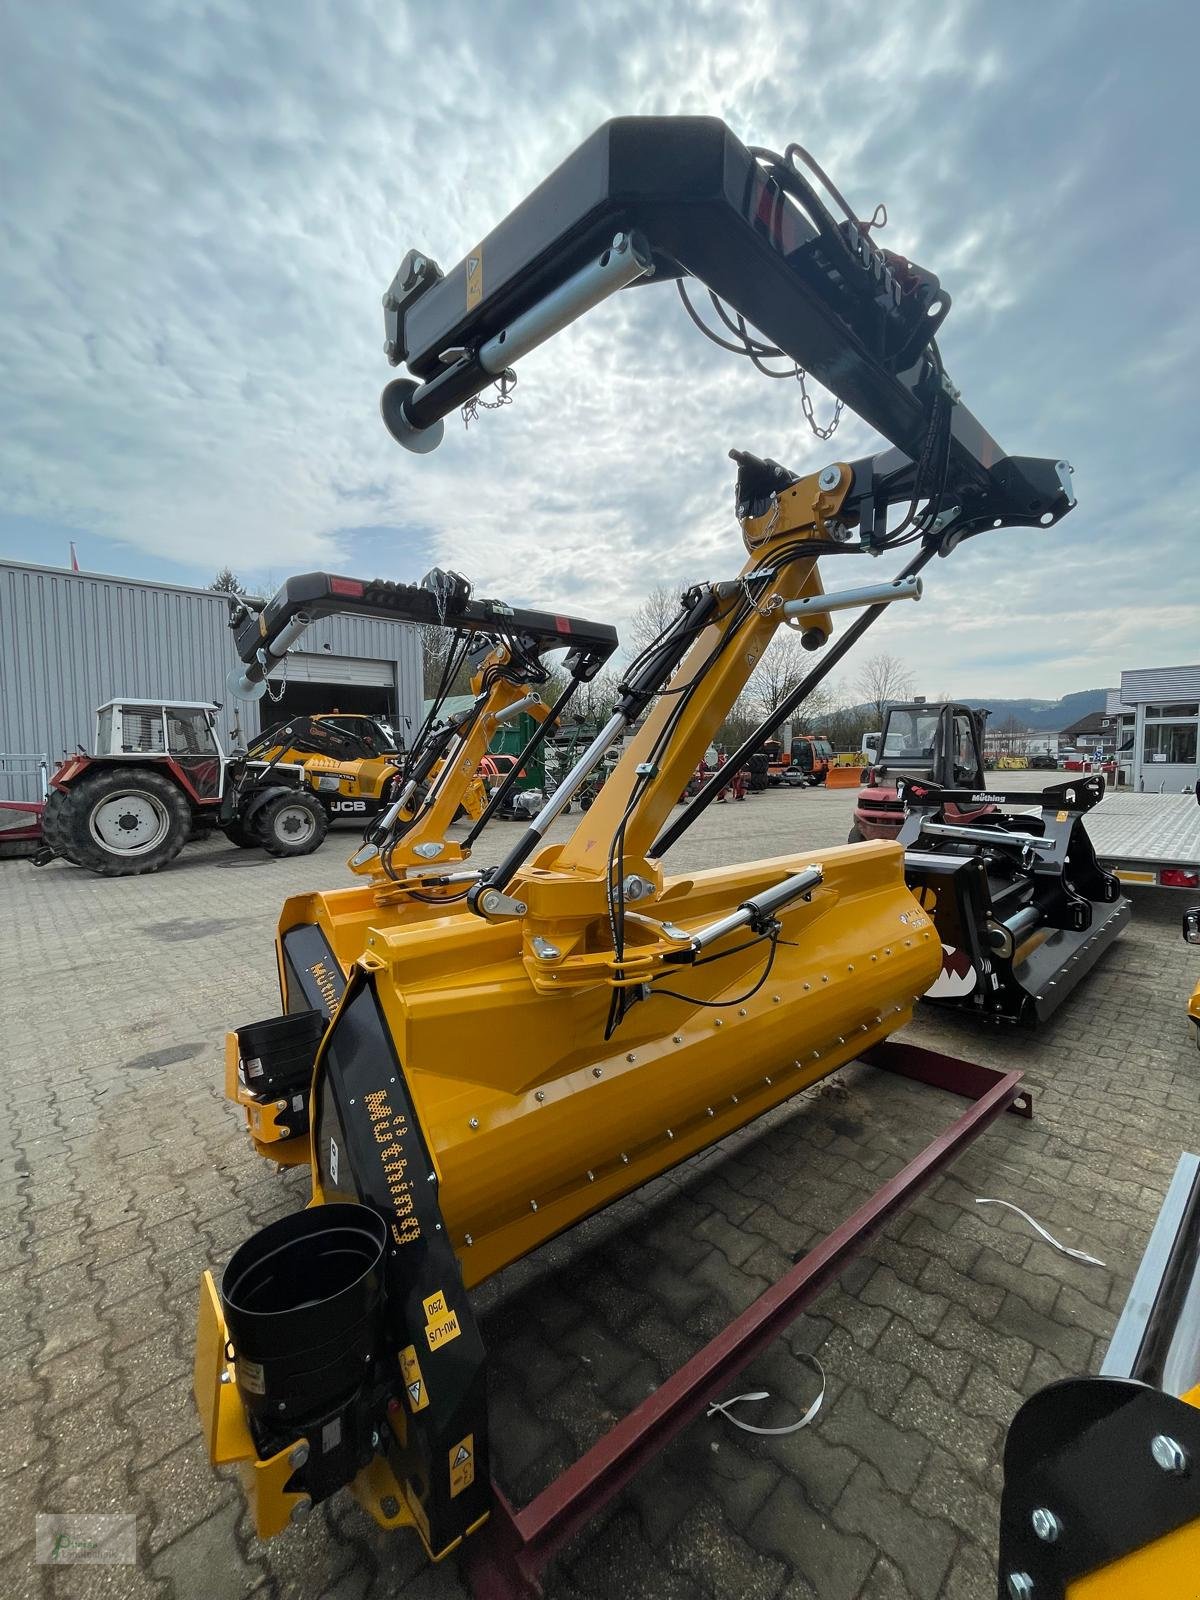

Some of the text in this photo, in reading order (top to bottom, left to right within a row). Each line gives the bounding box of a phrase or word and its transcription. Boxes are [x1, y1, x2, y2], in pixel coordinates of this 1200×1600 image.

[331, 802, 366, 812] JCB
[972, 793, 1006, 802] Müthing
[311, 962, 341, 1020] Müthin
[364, 1089, 421, 1244] Müthing
[428, 1298, 443, 1316] 250
[429, 1319, 457, 1343] MU-L/S
